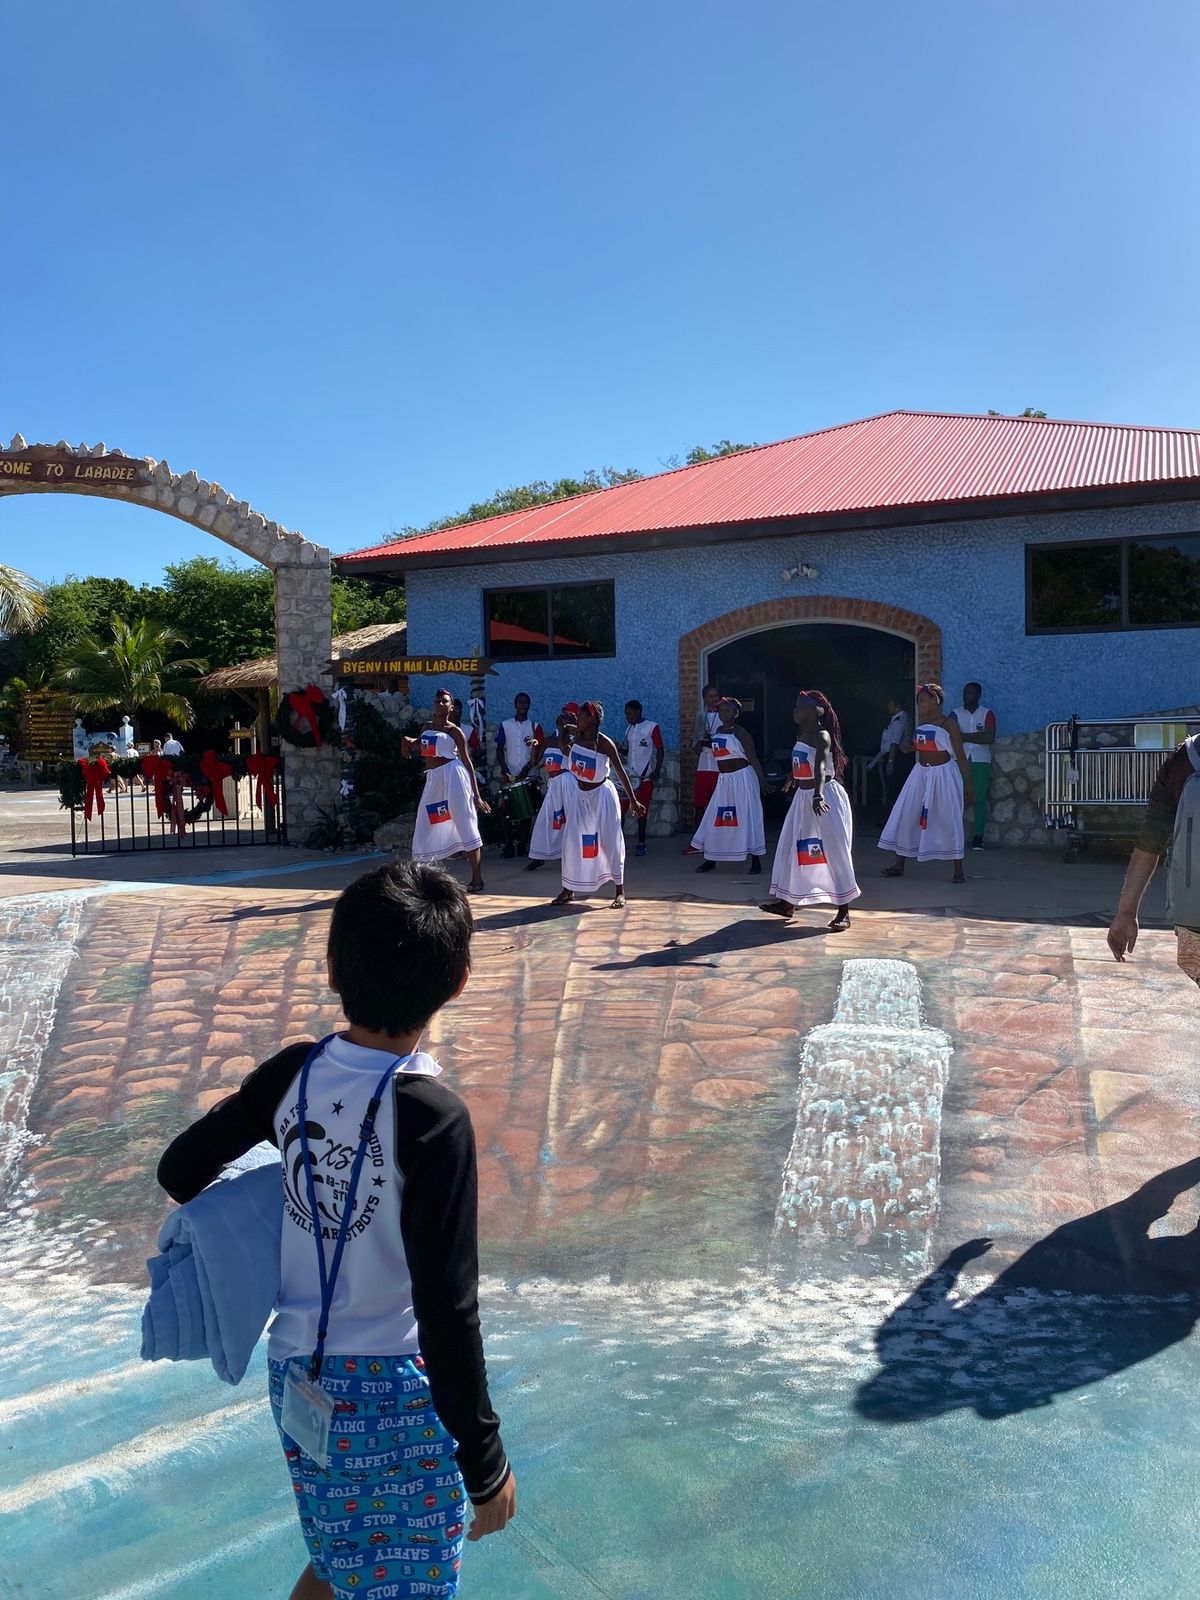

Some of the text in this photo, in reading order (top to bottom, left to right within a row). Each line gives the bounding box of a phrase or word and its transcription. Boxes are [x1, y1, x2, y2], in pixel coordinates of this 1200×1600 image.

[46, 463, 64, 477] TO
[74, 465, 135, 480] LABADEE
[425, 659, 478, 672] LABADEE
[361, 1381, 393, 1394] STOP
[402, 1375, 430, 1392] DRIV
[344, 1450, 398, 1469] SAFETY
[403, 1443, 444, 1459] DRIVE
[326, 1485, 361, 1498] STOP
[371, 1478, 424, 1497] SAFETY
[363, 1514, 397, 1527] STOP
[406, 1512, 447, 1529] DRIVE
[331, 1554, 364, 1569] STOP
[374, 1547, 430, 1562] SAFETY
[366, 1584, 399, 1600] STOP
[409, 1582, 449, 1596] DRIVE
